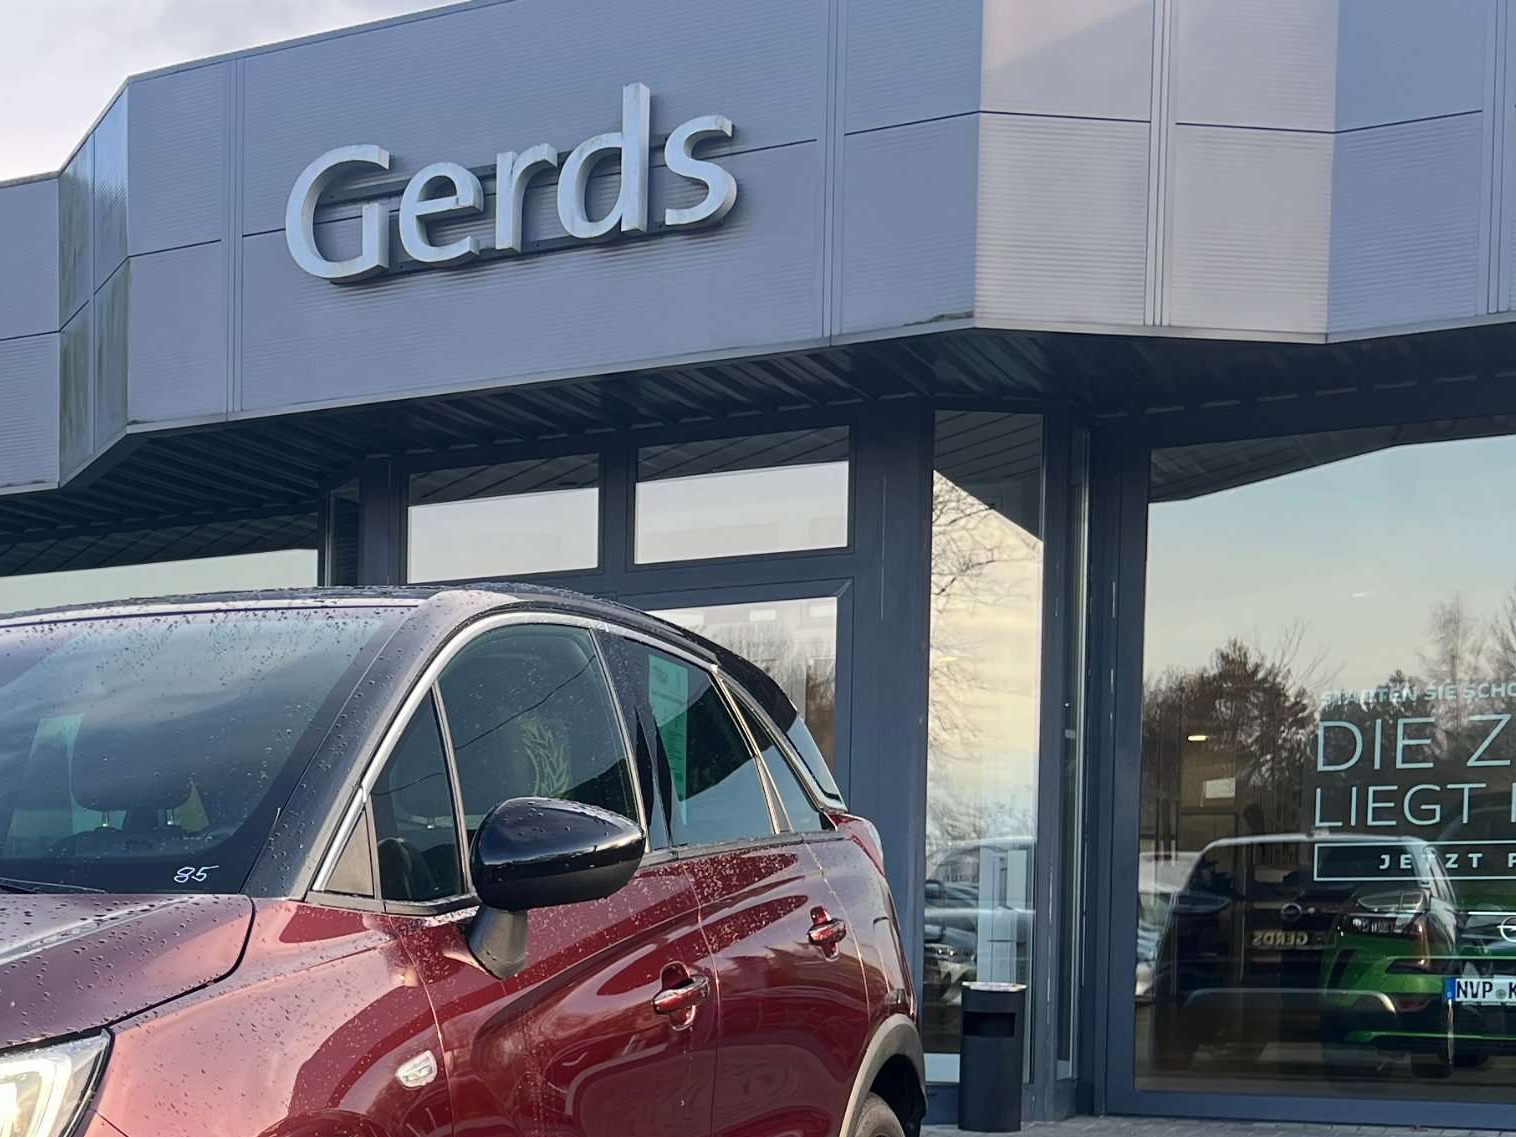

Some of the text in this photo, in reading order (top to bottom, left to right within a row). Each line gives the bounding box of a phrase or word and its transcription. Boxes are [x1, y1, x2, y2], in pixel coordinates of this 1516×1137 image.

[285, 81, 738, 281] Gerds
[1424, 684, 1457, 701] SIE
[1316, 713, 1512, 772] DIE Z
[1314, 782, 1487, 827] LIEGT
[173, 865, 220, 884] 85
[1456, 980, 1493, 999] NVP
